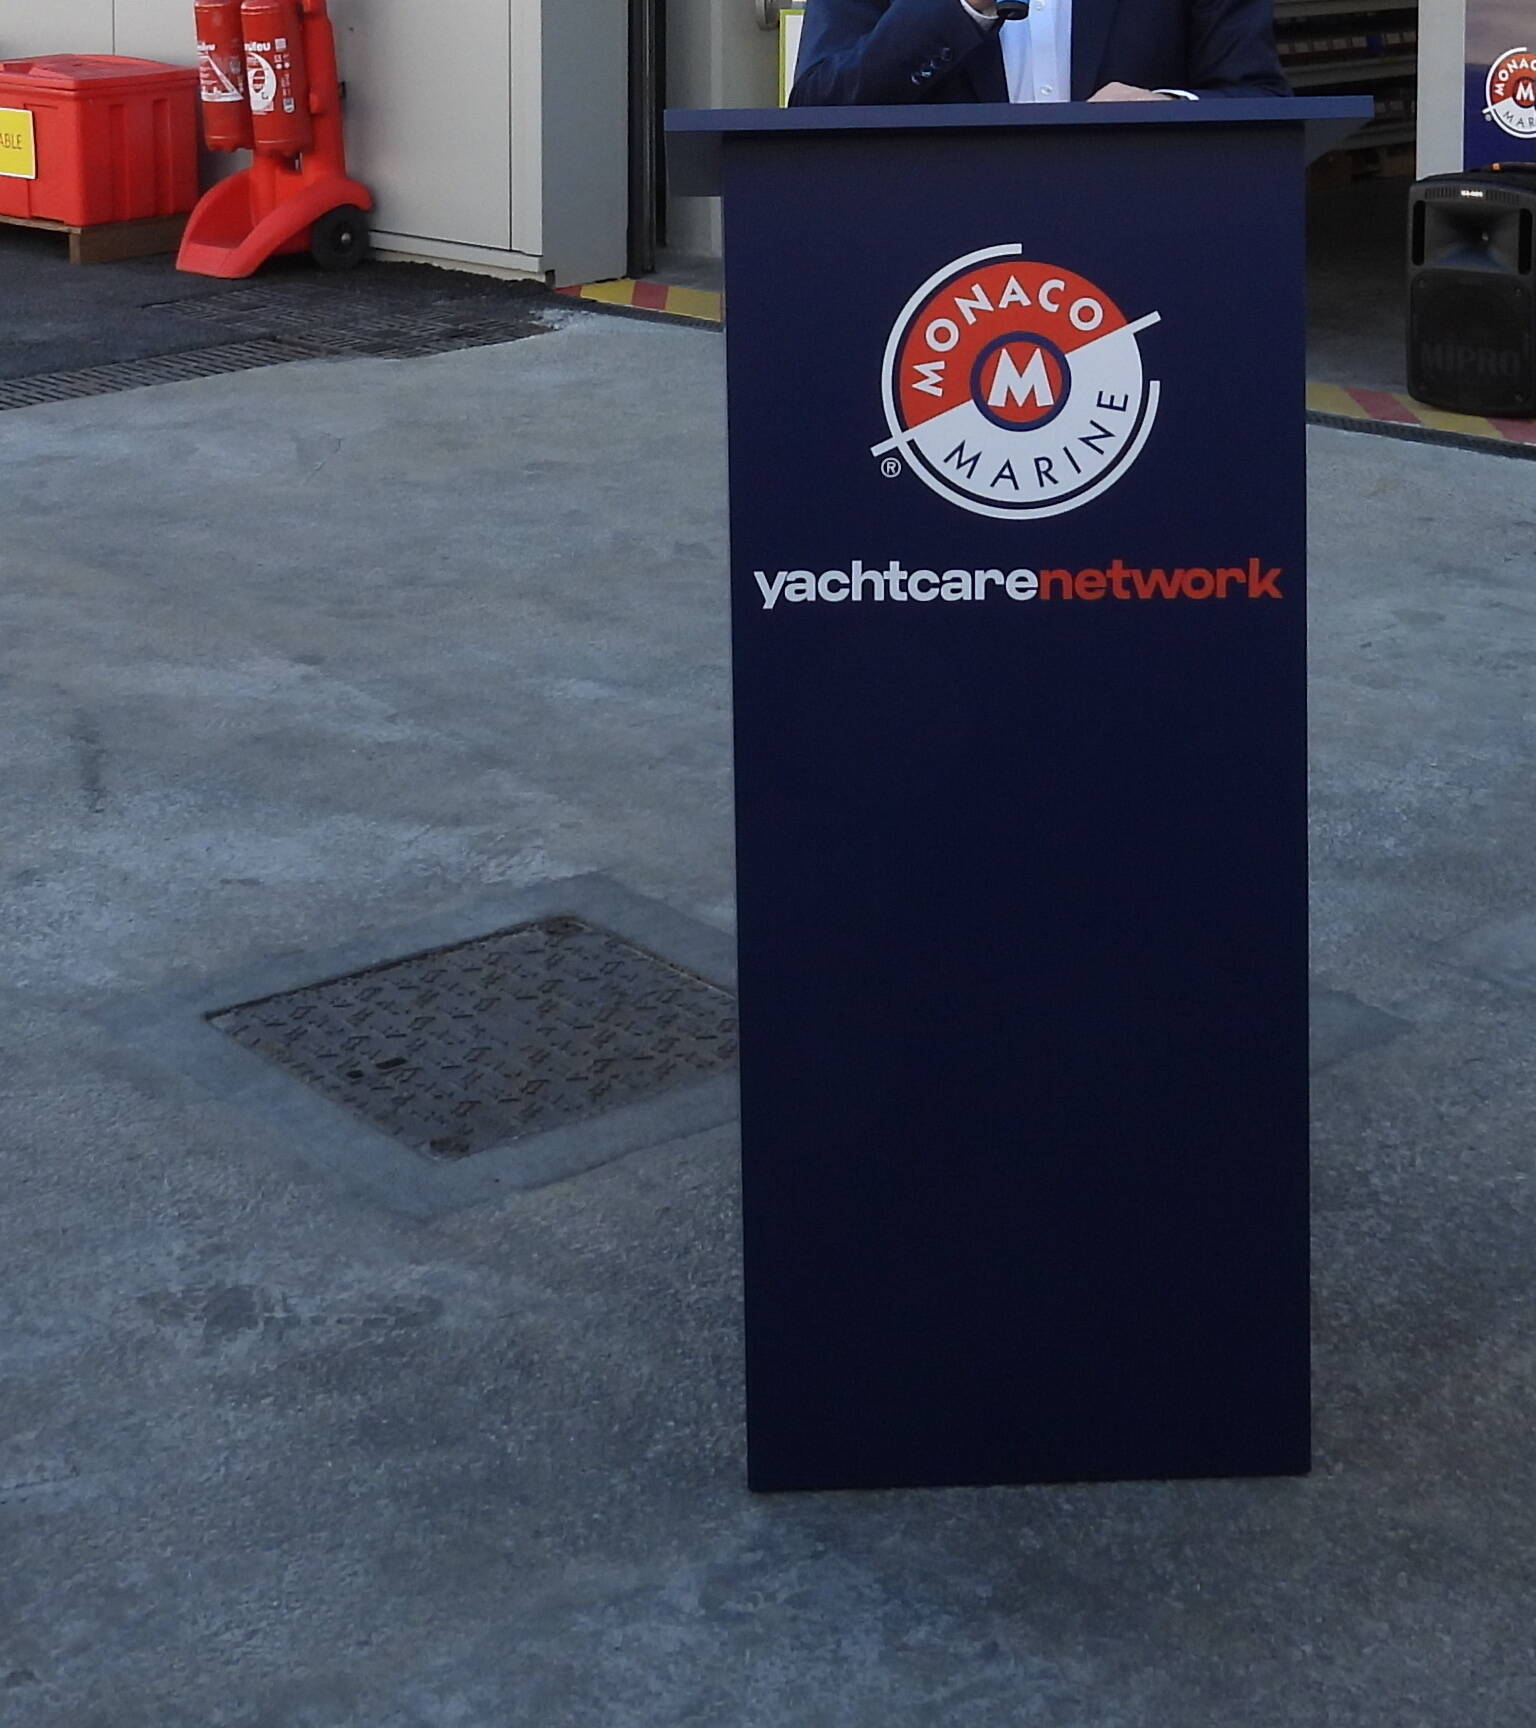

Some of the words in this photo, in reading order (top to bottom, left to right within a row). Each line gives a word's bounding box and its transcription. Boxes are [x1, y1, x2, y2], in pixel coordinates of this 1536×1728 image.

[1503, 110, 1536, 128] MAR
[1515, 81, 1535, 102] M
[912, 275, 1104, 397] MONACO
[986, 347, 1054, 408] M
[943, 389, 1130, 491] MARINE
[753, 558, 1284, 609] yachtcarenetwork
